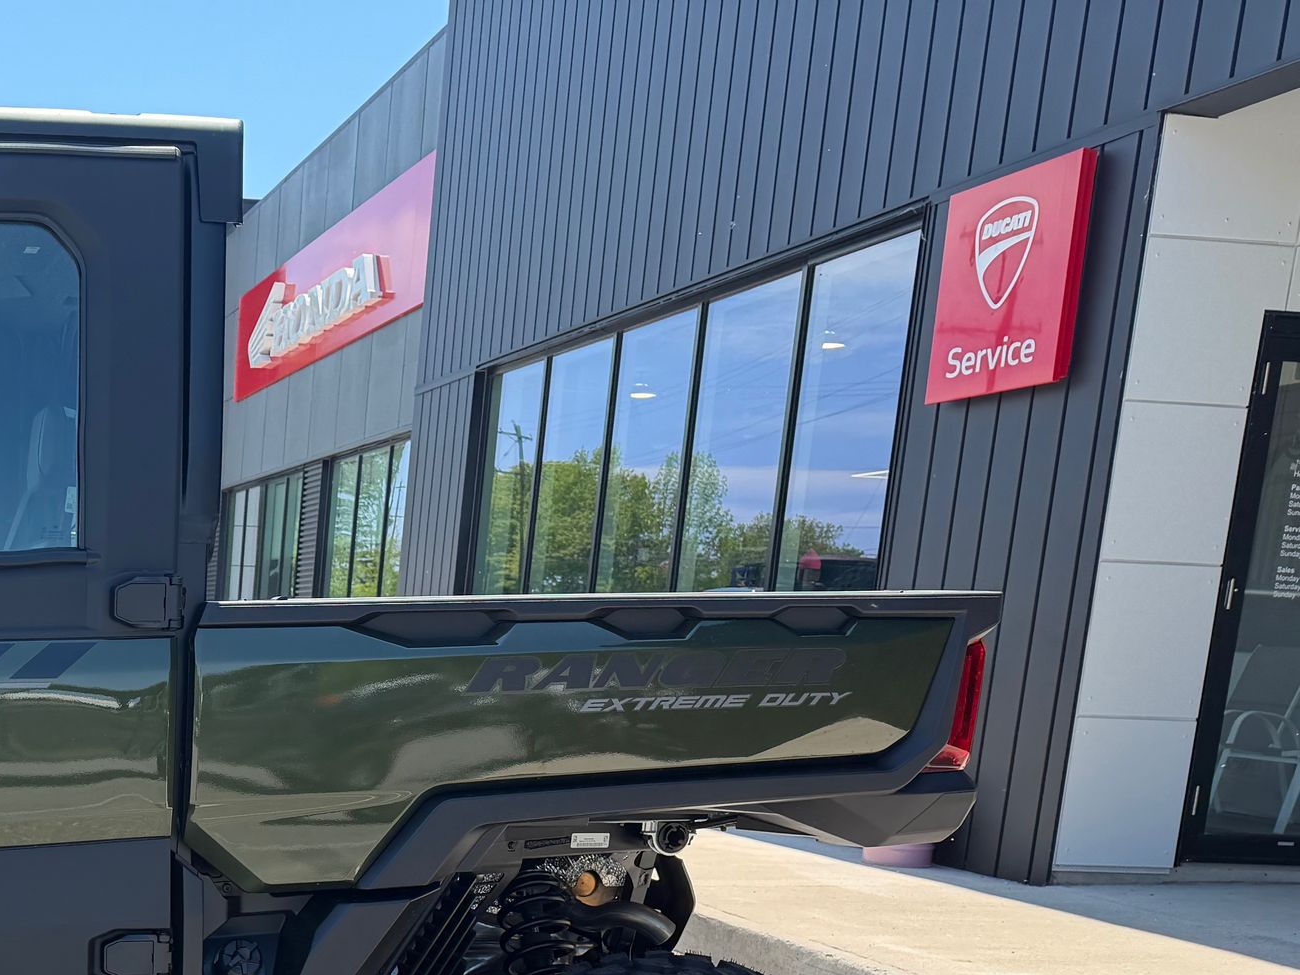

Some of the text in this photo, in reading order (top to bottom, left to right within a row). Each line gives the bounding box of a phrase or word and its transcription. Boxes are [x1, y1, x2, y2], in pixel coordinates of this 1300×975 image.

[981, 209, 1032, 241] DUCATI
[945, 336, 1036, 379] Service
[1277, 566, 1295, 574] Sales
[465, 647, 847, 694] RANGER
[580, 691, 852, 713] EXTREME DUTY
